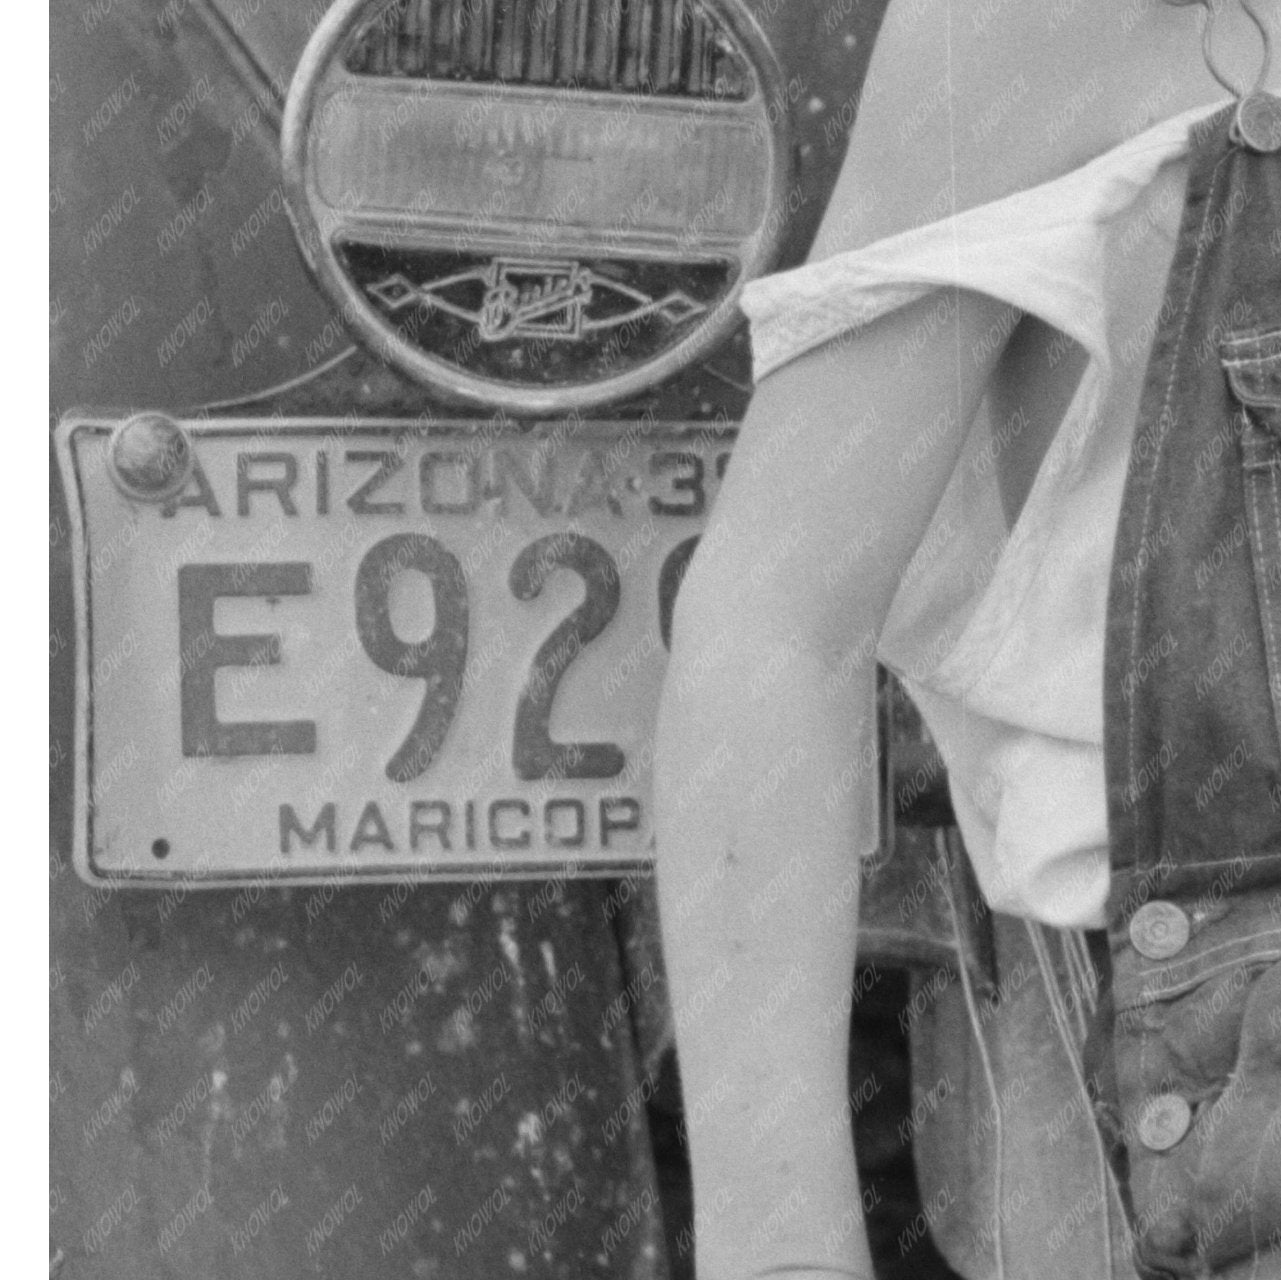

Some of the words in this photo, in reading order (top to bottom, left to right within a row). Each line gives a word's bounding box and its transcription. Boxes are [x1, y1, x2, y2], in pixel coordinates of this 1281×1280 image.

[648, 451, 732, 517] 3
[178, 531, 703, 783] E92
[279, 797, 656, 854] MARICOP
